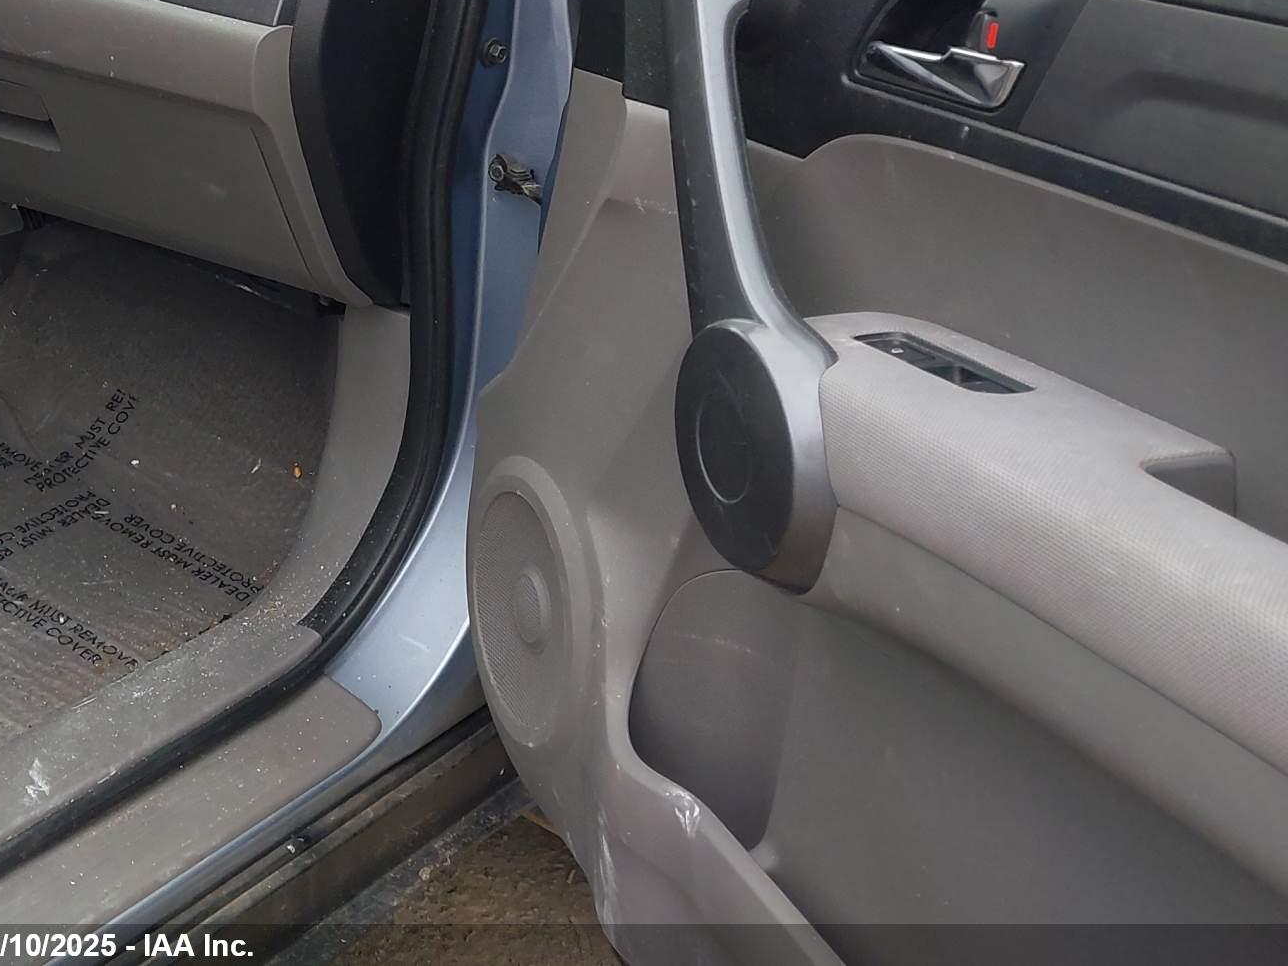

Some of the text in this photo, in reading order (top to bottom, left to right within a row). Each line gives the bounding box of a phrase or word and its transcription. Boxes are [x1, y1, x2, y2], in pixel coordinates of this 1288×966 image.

[74, 417, 106, 449] MUST
[36, 436, 110, 492] PROTECTIVE
[17, 527, 55, 548] MUST
[123, 513, 264, 594] PROTECTIVE COVER
[151, 546, 196, 571] MUST
[191, 567, 251, 602] DEALER
[29, 599, 73, 626] MUST
[45, 626, 103, 667] COVER
